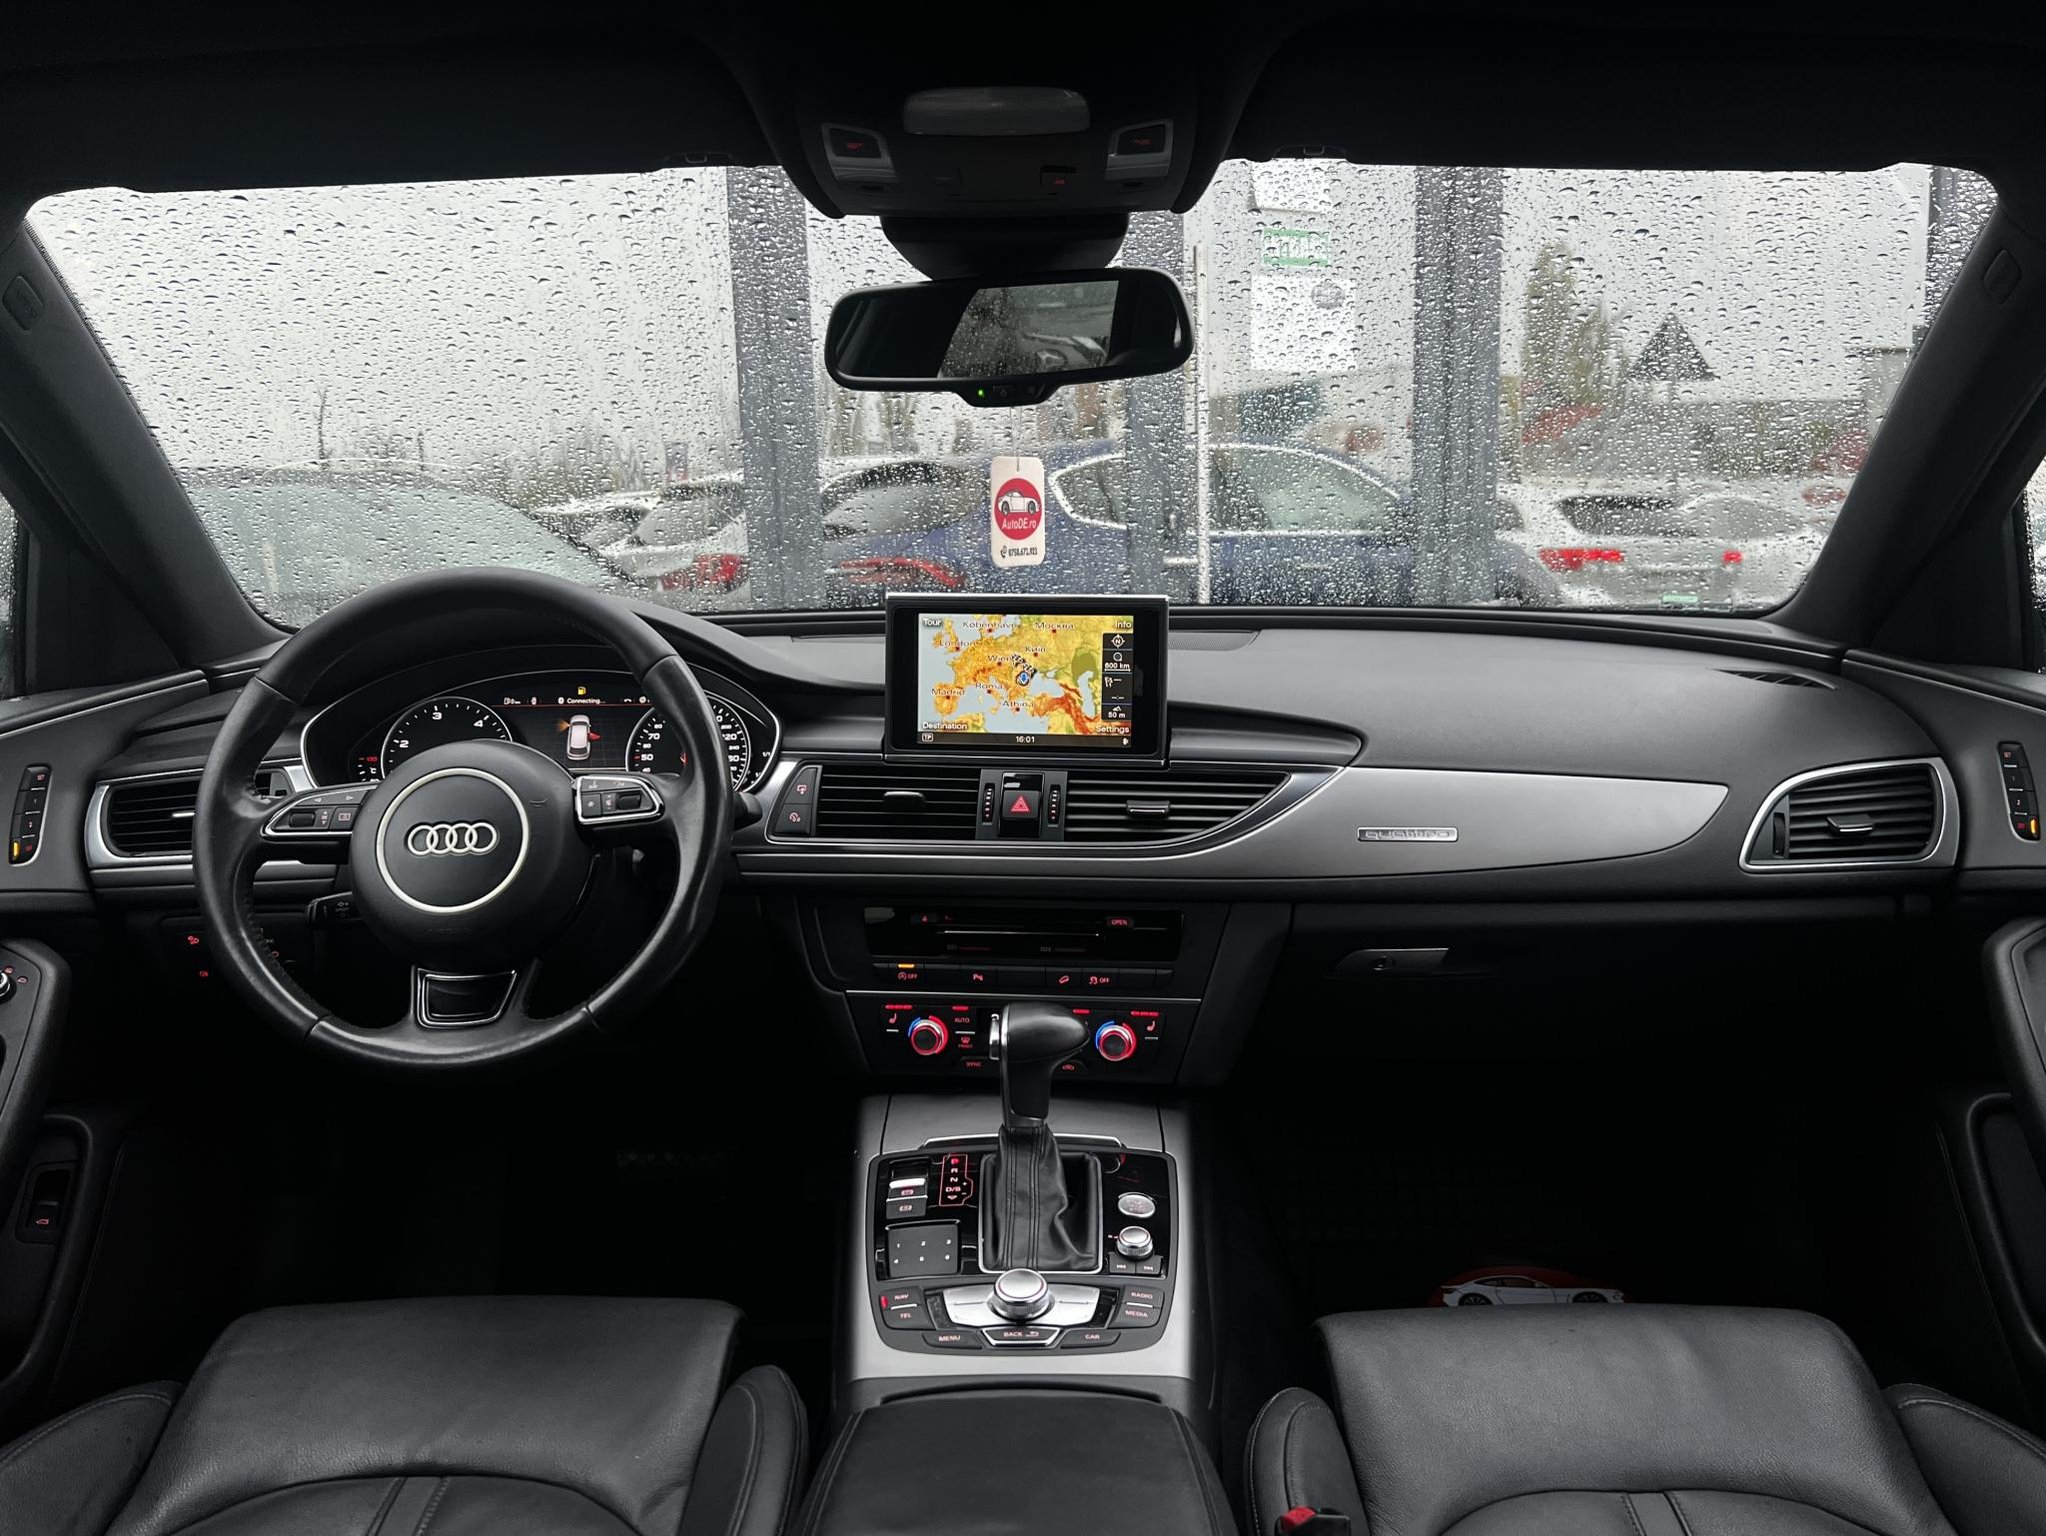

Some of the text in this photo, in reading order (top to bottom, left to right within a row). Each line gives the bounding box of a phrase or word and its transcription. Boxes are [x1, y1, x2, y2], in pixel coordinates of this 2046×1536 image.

[1002, 518, 1037, 530] AutoDE.ro
[923, 618, 941, 626] Tour
[962, 621, 1017, 629] København
[1115, 620, 1132, 628] Info
[939, 639, 975, 647] London
[975, 682, 1003, 690] Roma
[931, 688, 965, 696] Madrid
[432, 712, 442, 720] 3
[922, 721, 968, 730] Destination
[1096, 725, 1130, 734] Settings
[399, 740, 409, 748] 2
[1111, 918, 1128, 926] OPEN
[954, 1016, 971, 1024] AUTO
[1125, 1310, 1149, 1318] MEDIA
